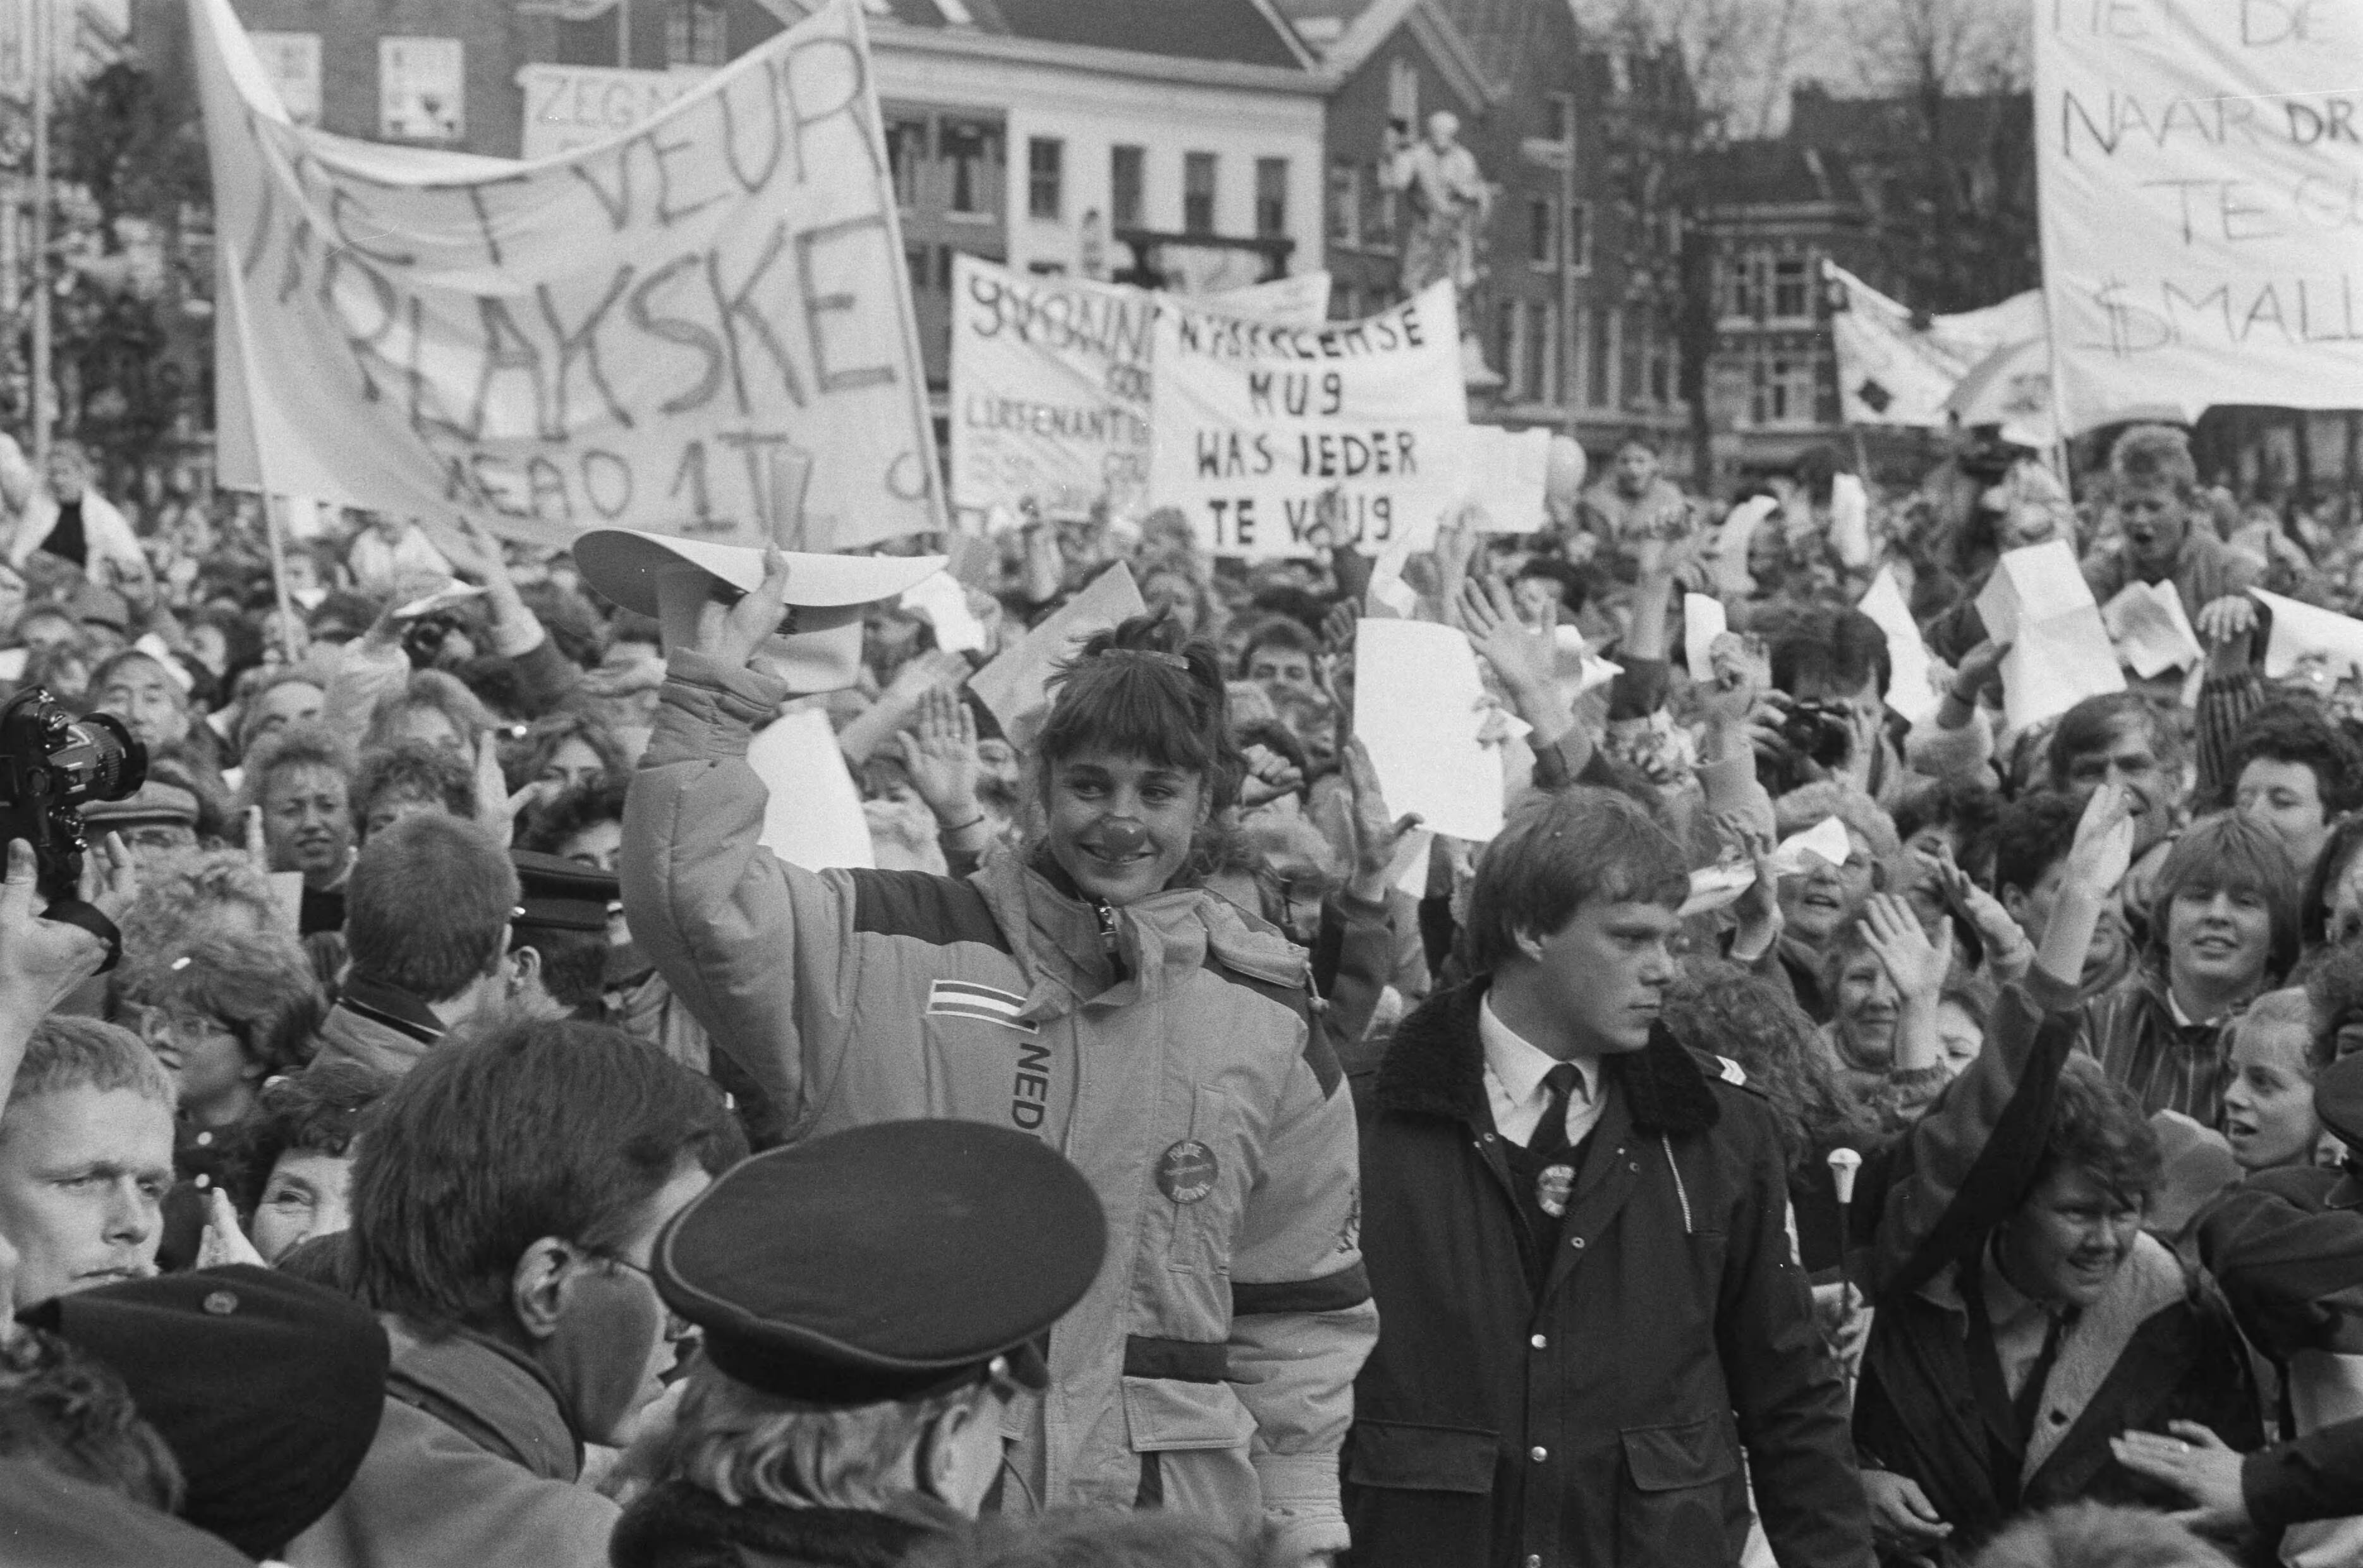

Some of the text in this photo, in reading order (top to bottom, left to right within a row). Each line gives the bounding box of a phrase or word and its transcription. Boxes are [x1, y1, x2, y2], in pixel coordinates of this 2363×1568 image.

[2062, 89, 2268, 159] NAAR
[1198, 430, 1273, 479] WAS
[1300, 431, 1417, 478] IEDER
[1208, 497, 1254, 545] TE
